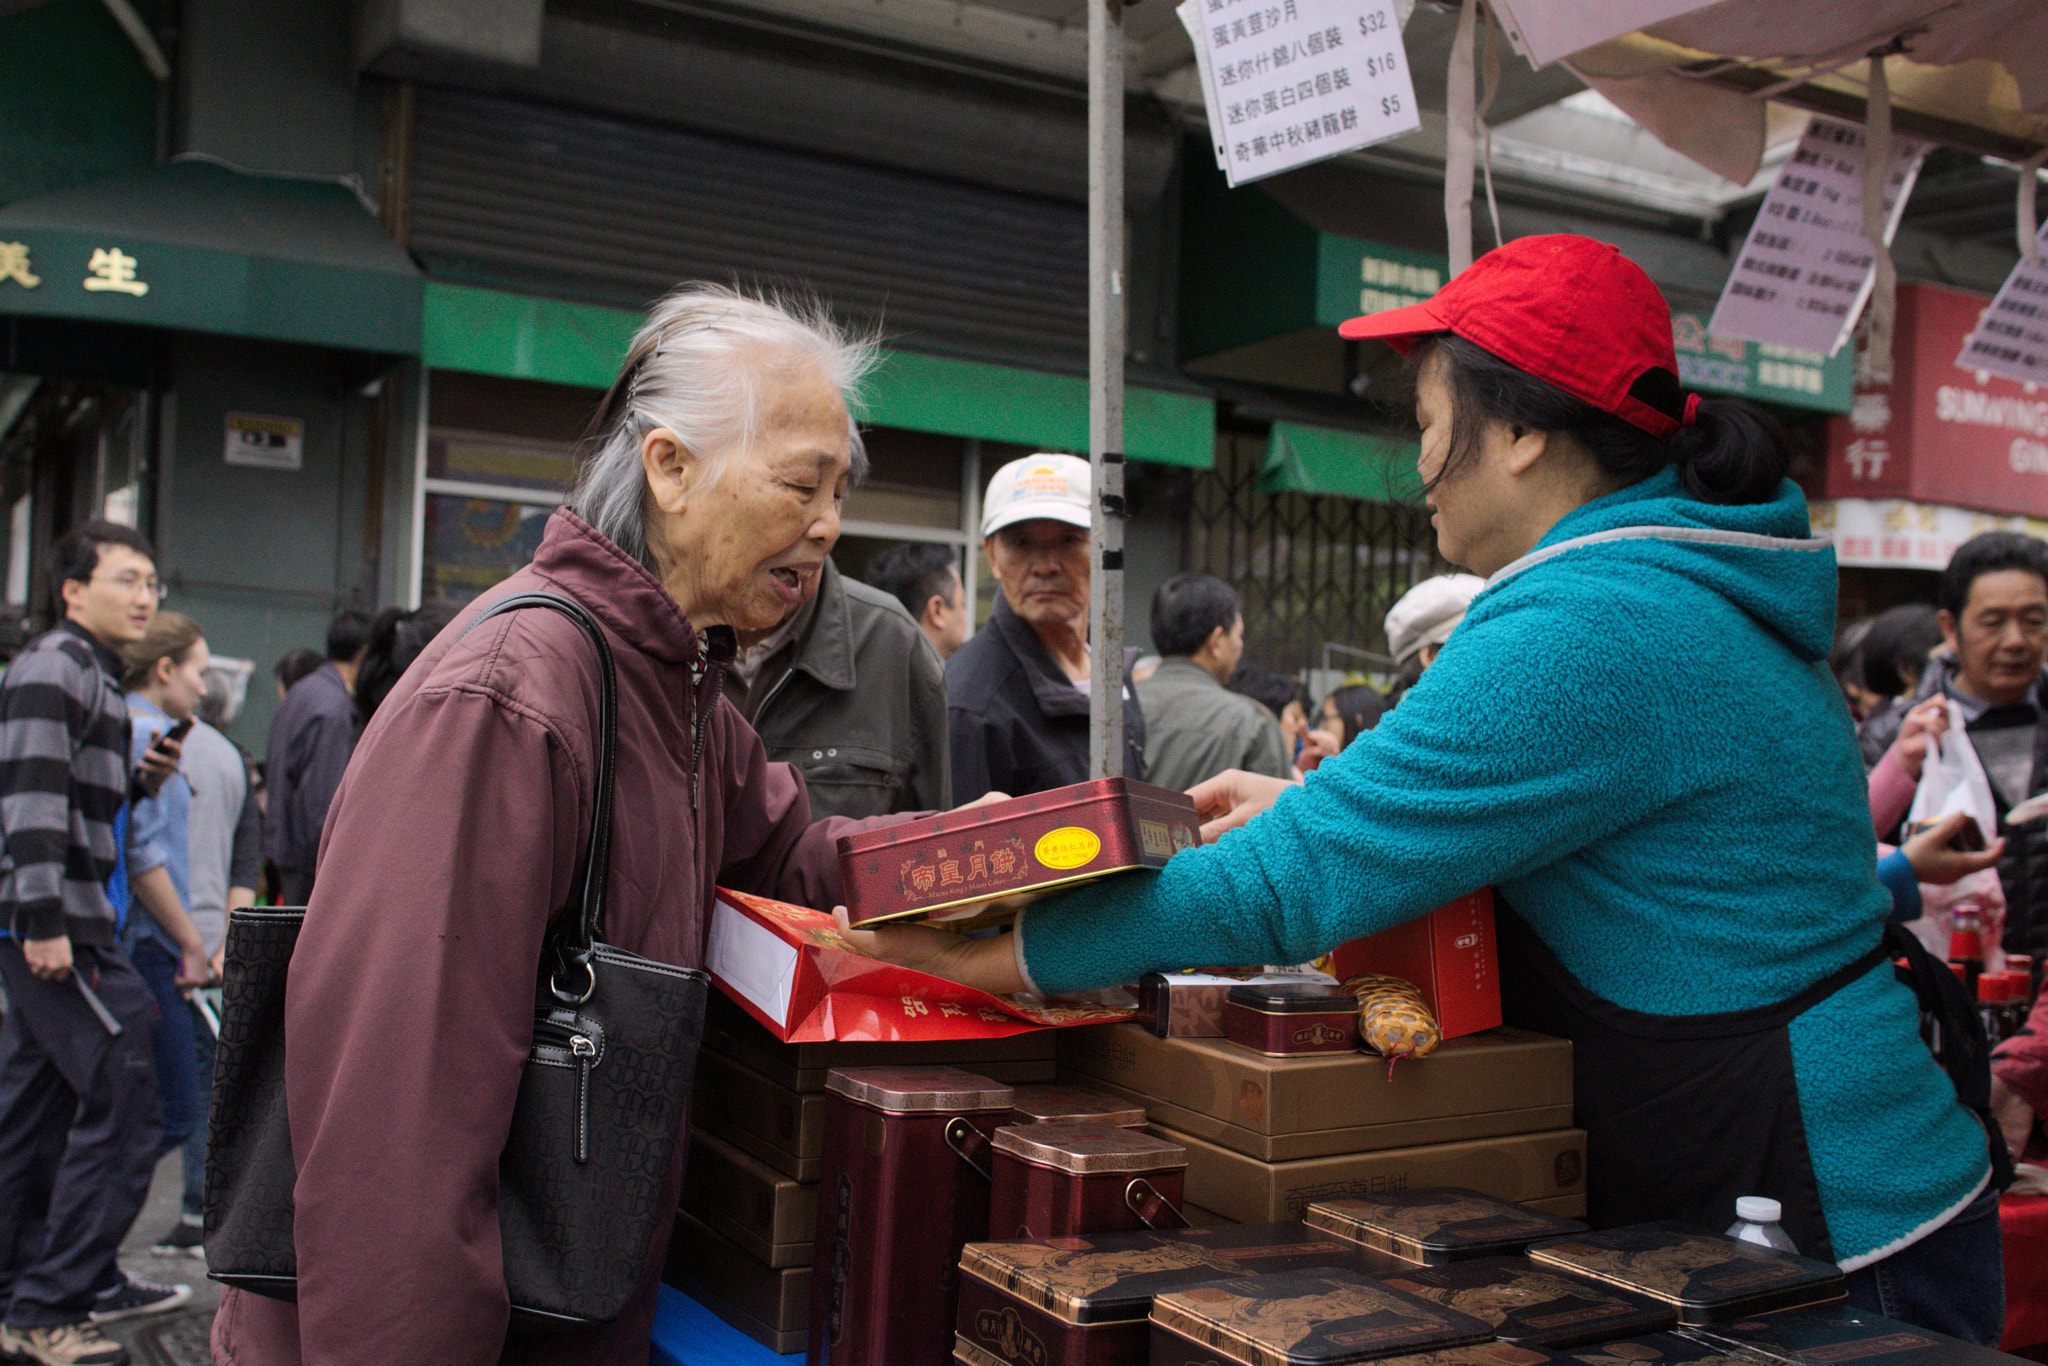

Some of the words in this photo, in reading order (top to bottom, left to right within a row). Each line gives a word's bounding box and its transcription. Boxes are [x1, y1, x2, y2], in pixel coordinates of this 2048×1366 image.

[1359, 10, 1387, 36] $32
[1226, 67, 1351, 126] 迷你蛋白四個裝
[1367, 52, 1396, 78] $16
[1382, 94, 1401, 117] $5
[911, 847, 1016, 892] 帝皇月餅
